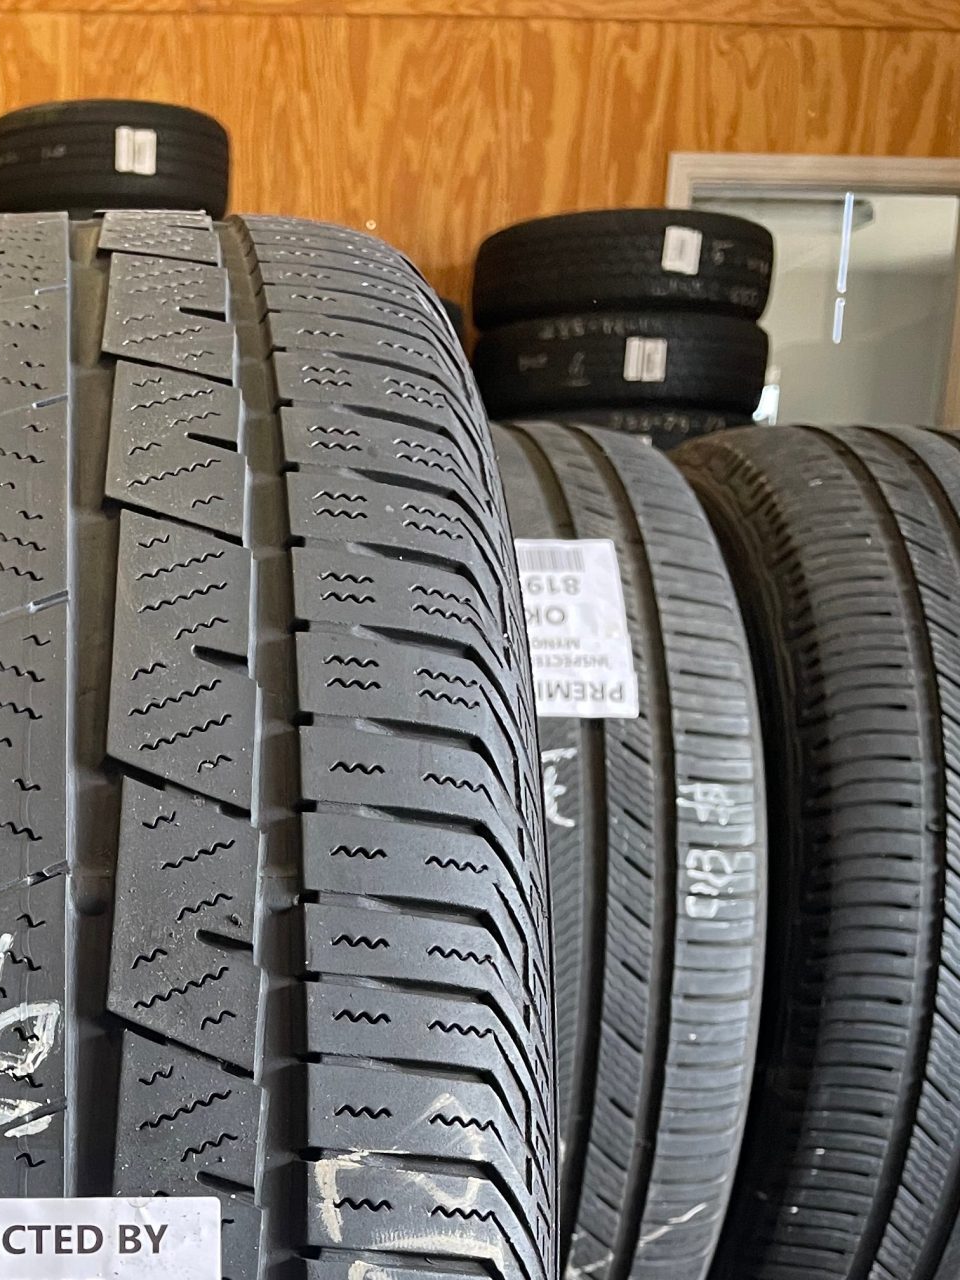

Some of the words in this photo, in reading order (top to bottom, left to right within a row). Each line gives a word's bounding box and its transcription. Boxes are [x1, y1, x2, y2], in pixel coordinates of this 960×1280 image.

[526, 576, 581, 595] 819
[527, 604, 565, 624] OK
[534, 654, 610, 669] INSPECTE
[538, 681, 625, 702] PREMI
[120, 1225, 167, 1253] BY
